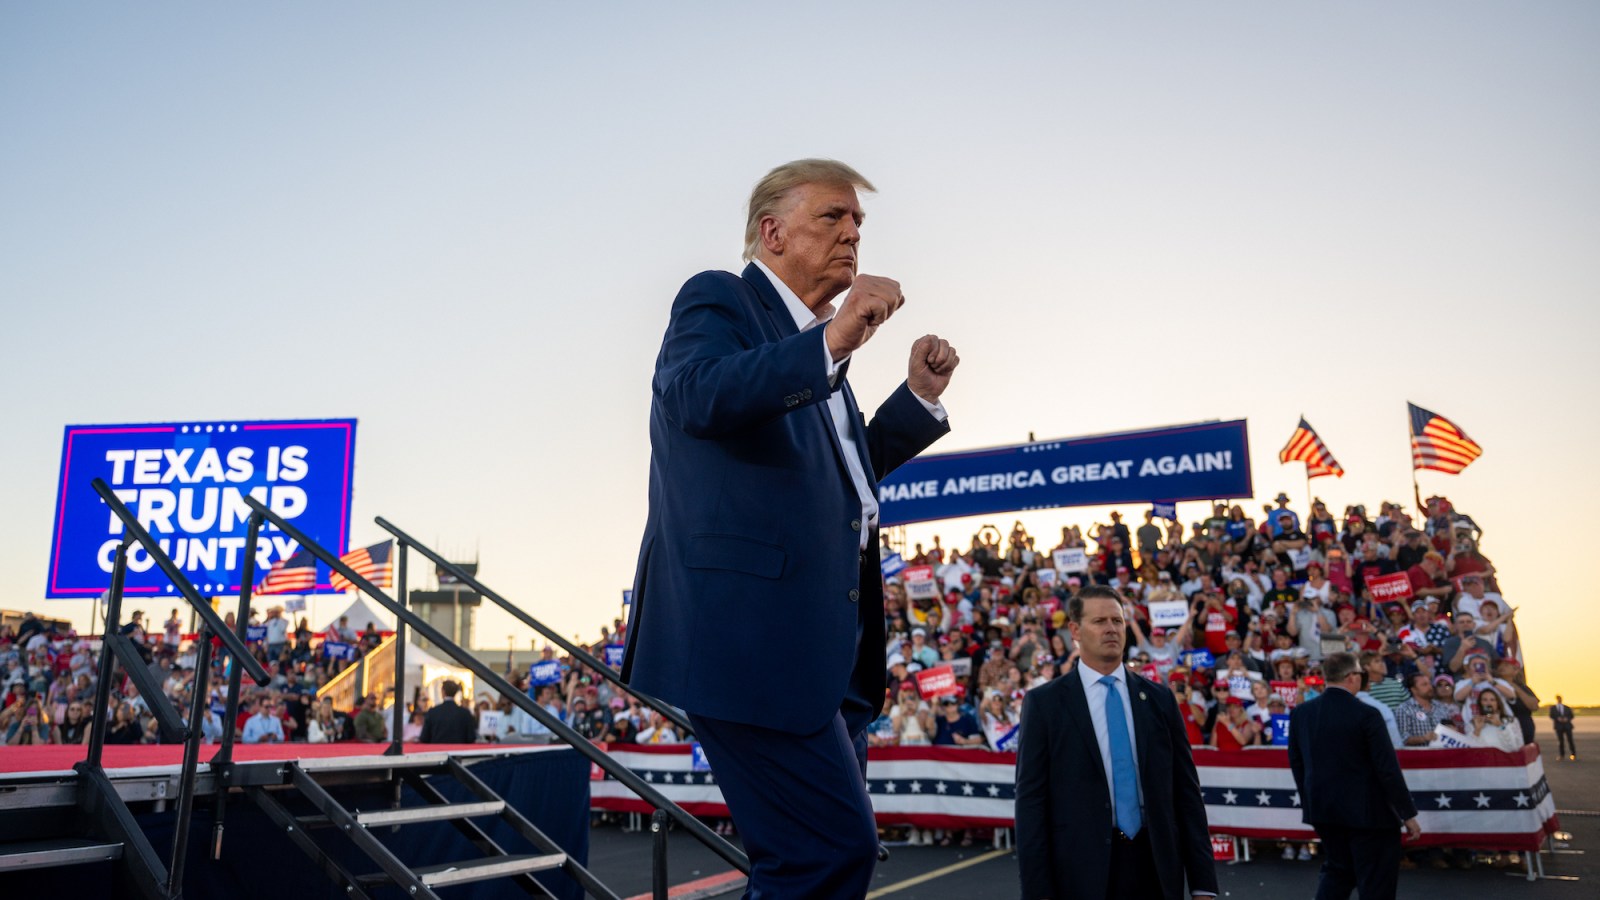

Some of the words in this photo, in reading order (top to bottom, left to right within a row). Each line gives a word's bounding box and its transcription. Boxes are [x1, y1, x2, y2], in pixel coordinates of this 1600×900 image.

[105, 446, 255, 485] TEXAS
[266, 445, 309, 483] IS
[879, 479, 939, 503] MAKE
[942, 470, 1047, 496] AMERICA
[1051, 460, 1134, 485] GREAT
[1139, 450, 1234, 477] AGAIN!
[101, 486, 308, 535] TRUMP
[97, 537, 301, 573] COUNTRY
[1371, 583, 1409, 598] TRUMP
[921, 678, 954, 693] TRUMP
